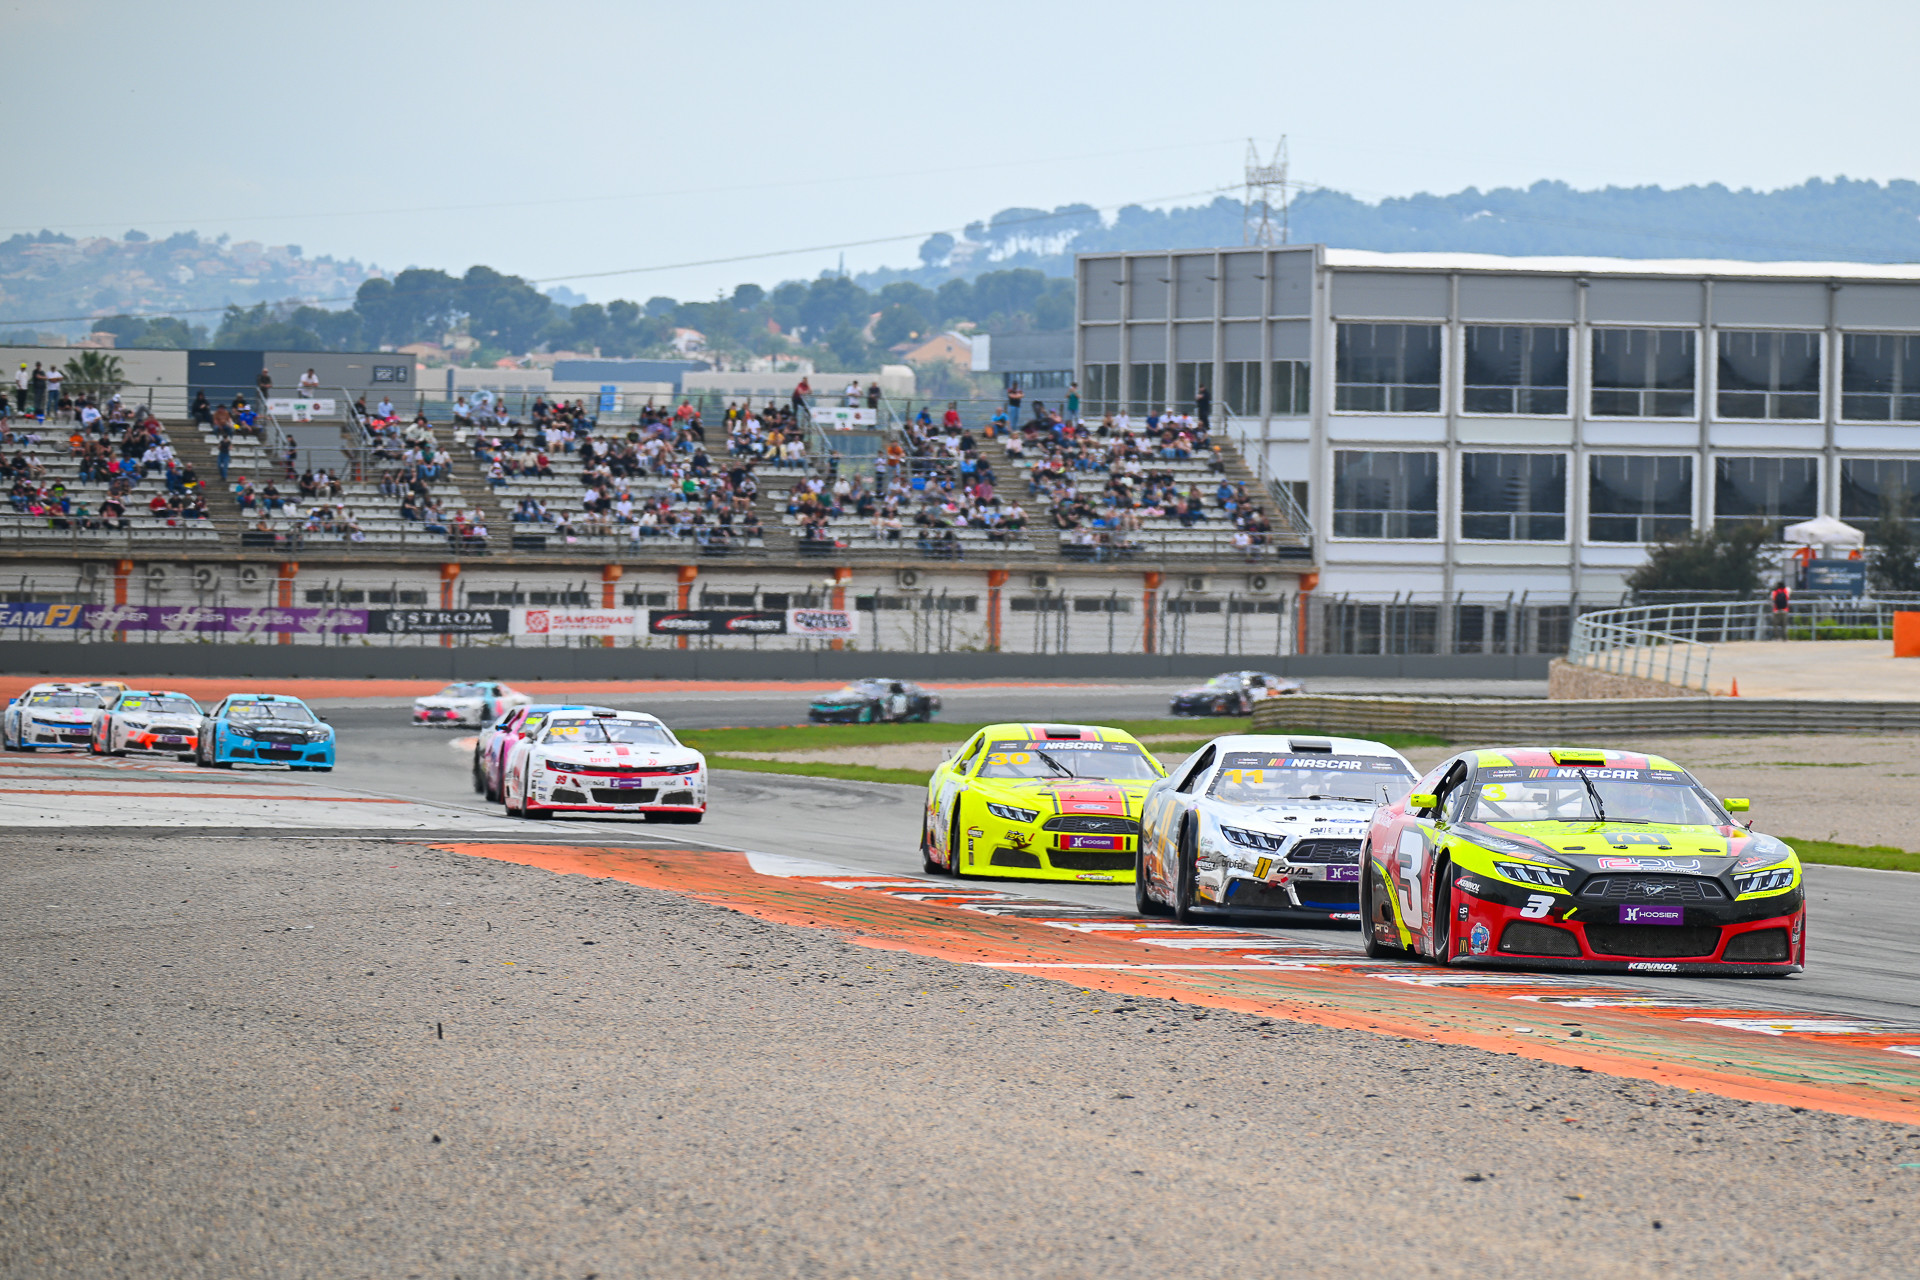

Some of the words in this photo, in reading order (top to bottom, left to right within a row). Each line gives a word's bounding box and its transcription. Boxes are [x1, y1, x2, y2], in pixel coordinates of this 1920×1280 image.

[408, 611, 493, 625] STROM
[550, 727, 579, 736] 99
[1043, 742, 1104, 751] NASCAR
[988, 752, 1031, 765] 30
[1291, 758, 1362, 770] NASCAR
[555, 775, 568, 785] 99
[1223, 769, 1264, 784] 11
[1557, 769, 1639, 780] NASCAR
[1482, 783, 1507, 802] 3
[1397, 830, 1423, 930] 3
[1456, 878, 1481, 893] KENNOL
[1519, 894, 1556, 919] 3
[1638, 911, 1679, 919] HOOSIER
[1627, 962, 1678, 971] KENNOL
